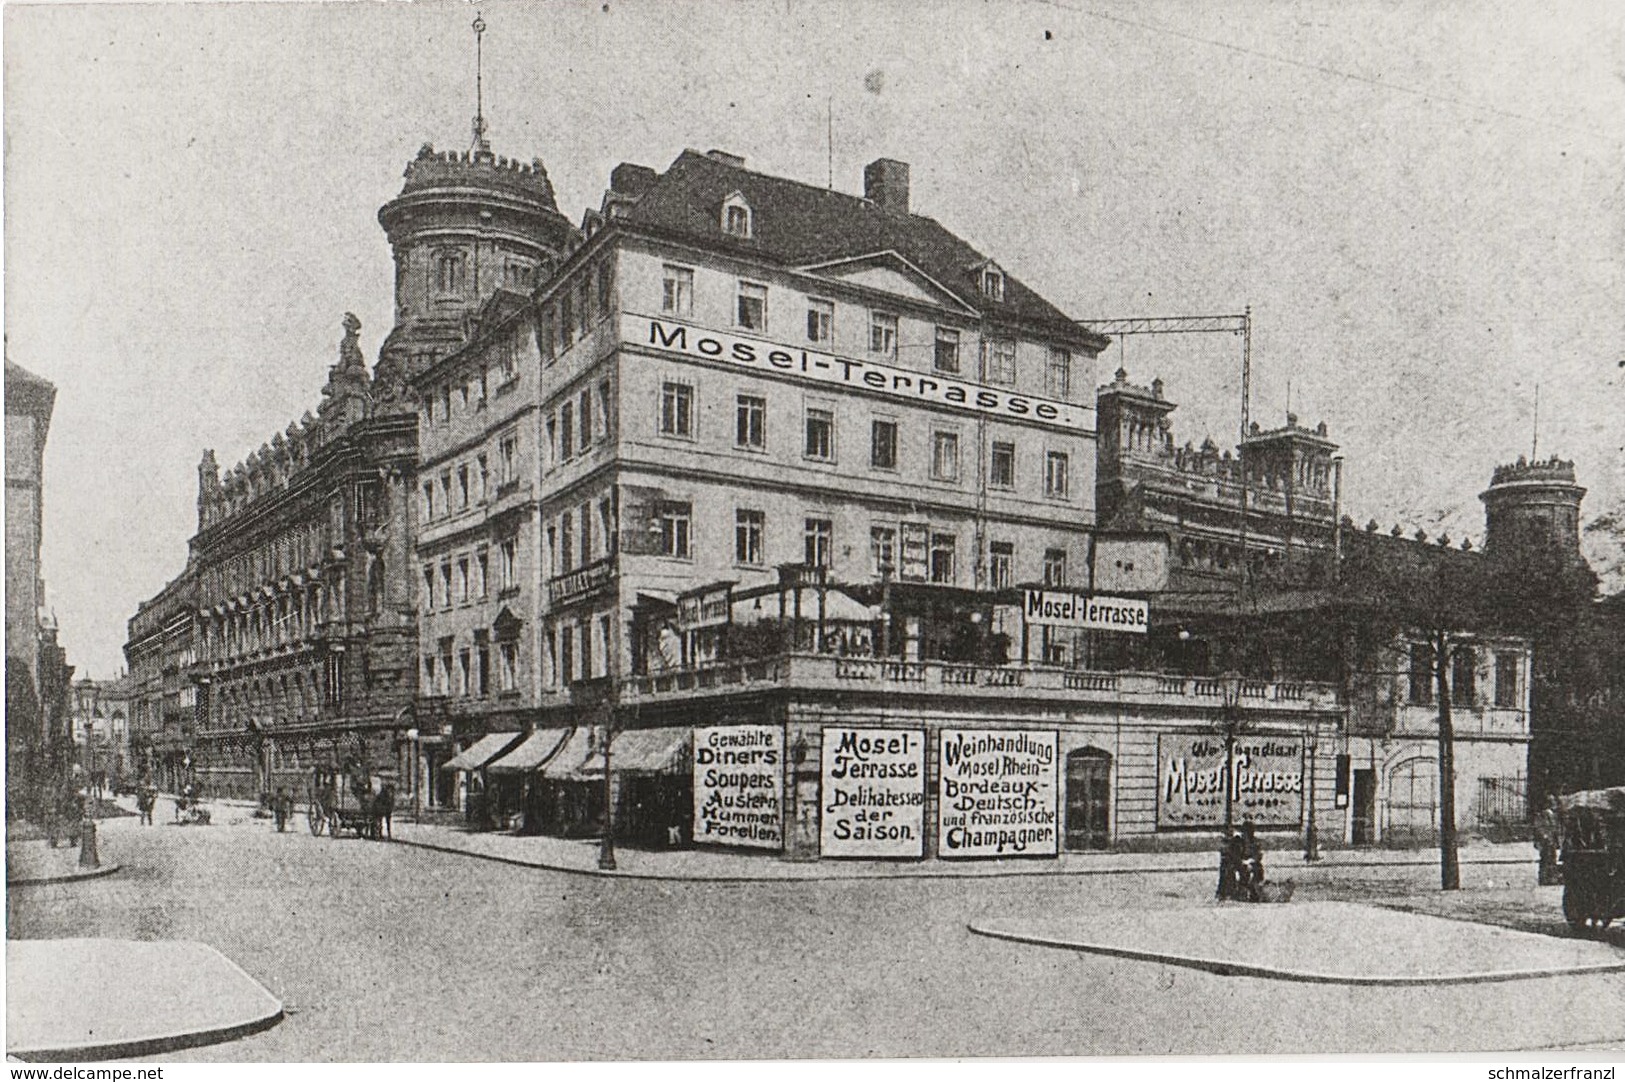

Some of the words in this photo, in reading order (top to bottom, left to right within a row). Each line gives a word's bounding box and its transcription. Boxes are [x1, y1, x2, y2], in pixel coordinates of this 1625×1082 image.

[708, 730, 773, 747] Gewählte
[834, 732, 917, 762] Mosel-
[697, 747, 778, 765] Diners
[945, 733, 1053, 767] Weinhandlung
[831, 755, 918, 779] Terrasse
[704, 769, 774, 794] Soupers
[943, 776, 1049, 799] Bordeaux-
[706, 790, 778, 810] Austern
[952, 794, 1045, 812] Deutsch-
[701, 806, 779, 825] Hummer
[855, 809, 893, 822] der
[943, 812, 967, 827] und
[970, 806, 1055, 826] französische
[705, 821, 780, 842] Forellen.
[833, 819, 915, 841] Saison.
